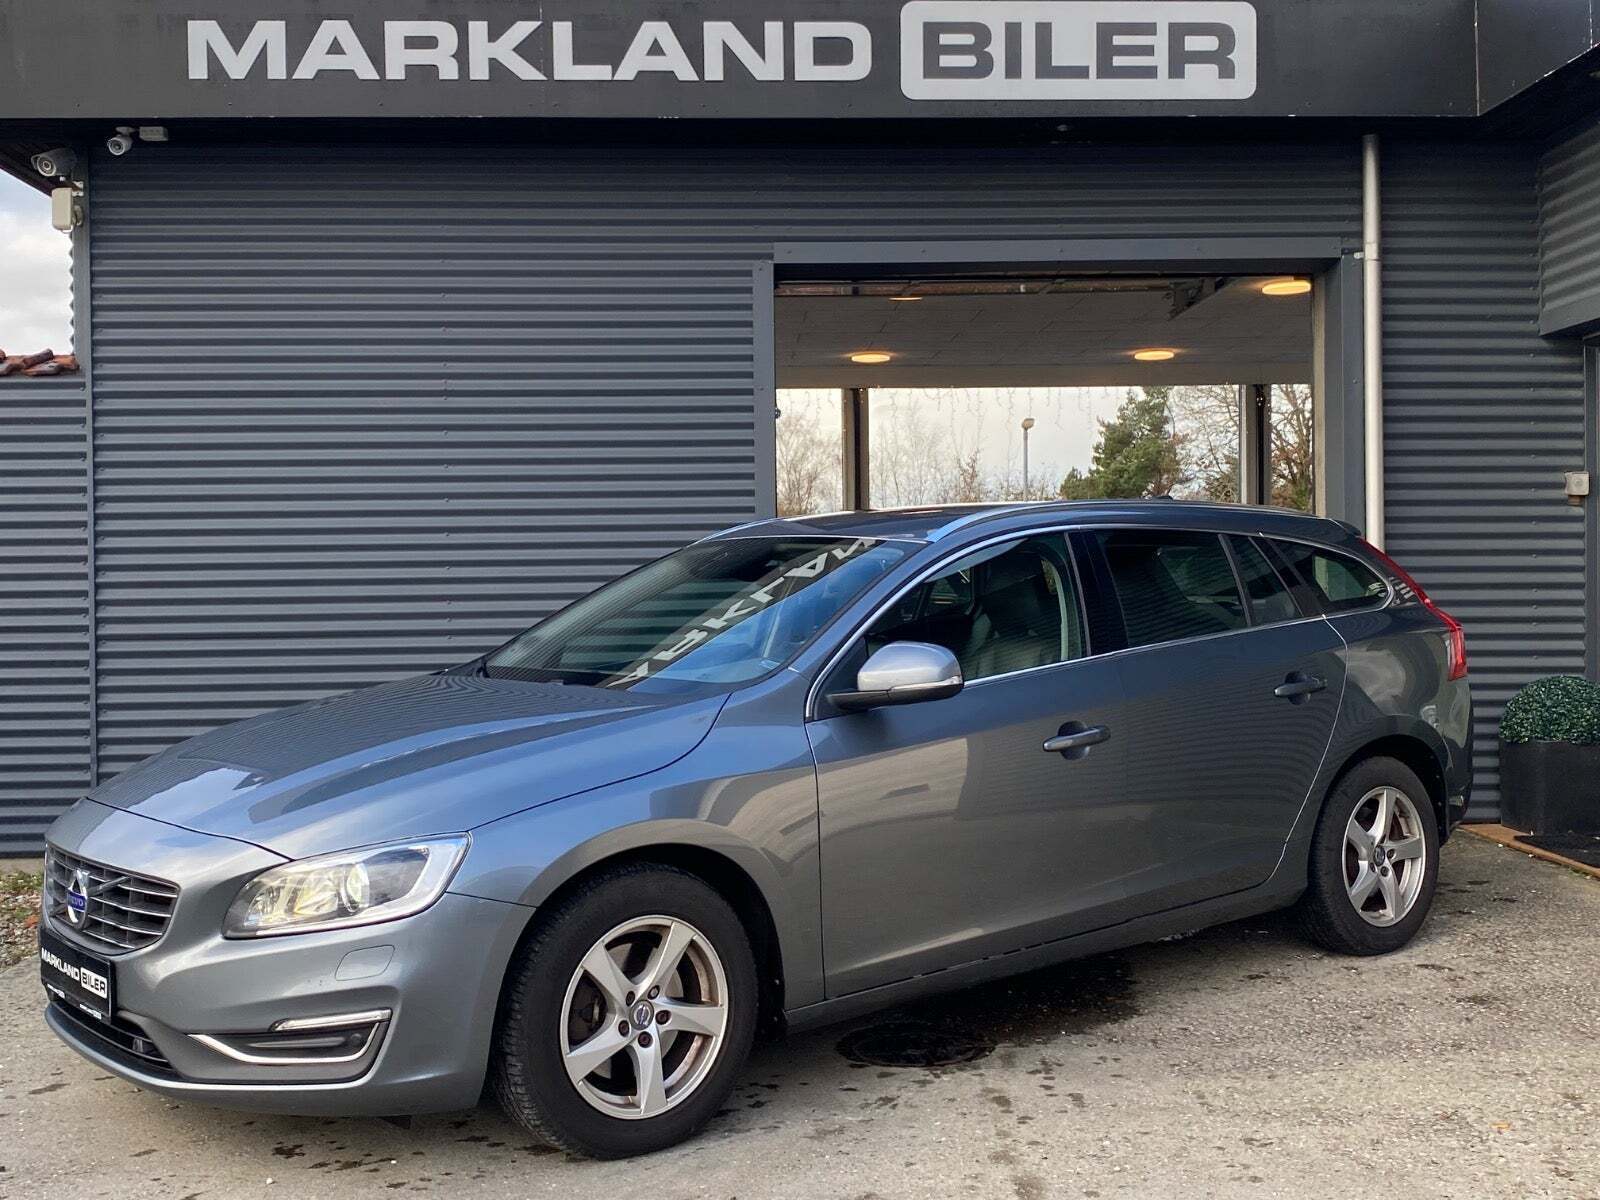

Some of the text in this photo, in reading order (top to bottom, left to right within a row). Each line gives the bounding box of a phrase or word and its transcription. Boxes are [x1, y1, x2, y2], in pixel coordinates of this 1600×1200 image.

[187, 20, 1237, 81] MARKLAND BILER
[41, 947, 80, 981] MARKLAND
[82, 972, 106, 995] BILER
